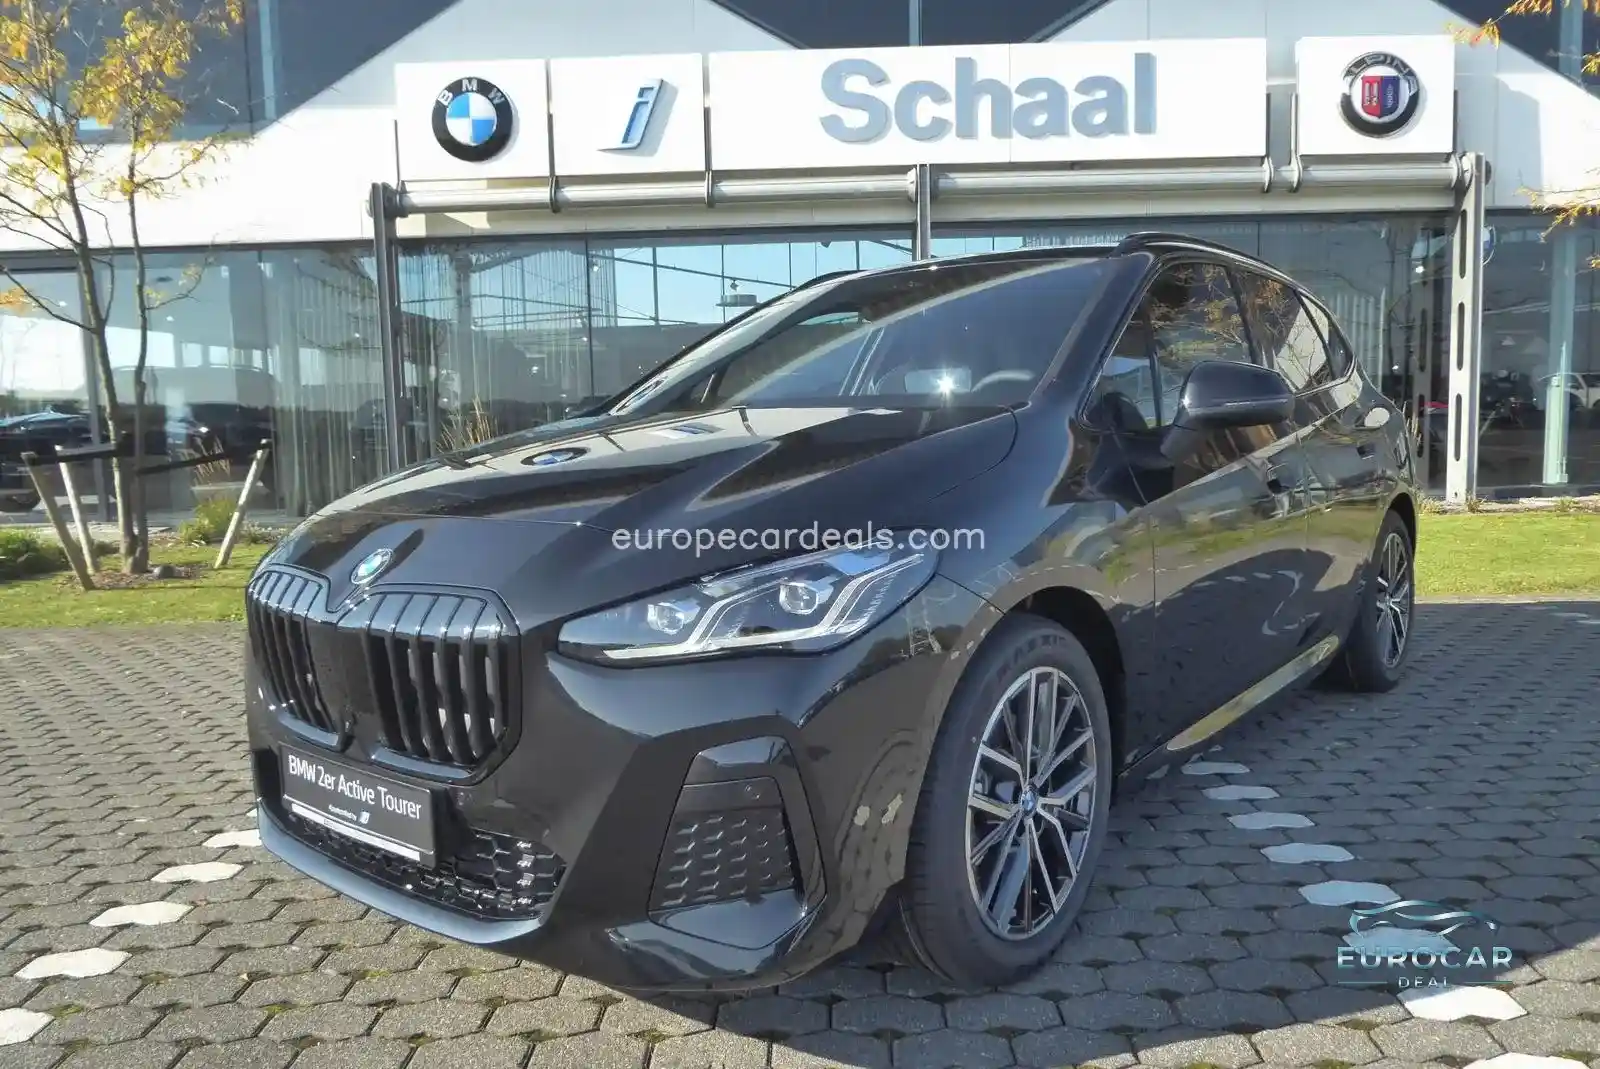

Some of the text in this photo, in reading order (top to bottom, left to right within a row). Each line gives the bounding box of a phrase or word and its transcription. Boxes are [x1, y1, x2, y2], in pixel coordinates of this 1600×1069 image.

[436, 78, 504, 106] BMW
[819, 52, 1157, 144] Schaal
[288, 754, 316, 783] BMW
[317, 766, 336, 790] 2er
[337, 774, 376, 805] Active
[377, 786, 422, 819] Tourer
